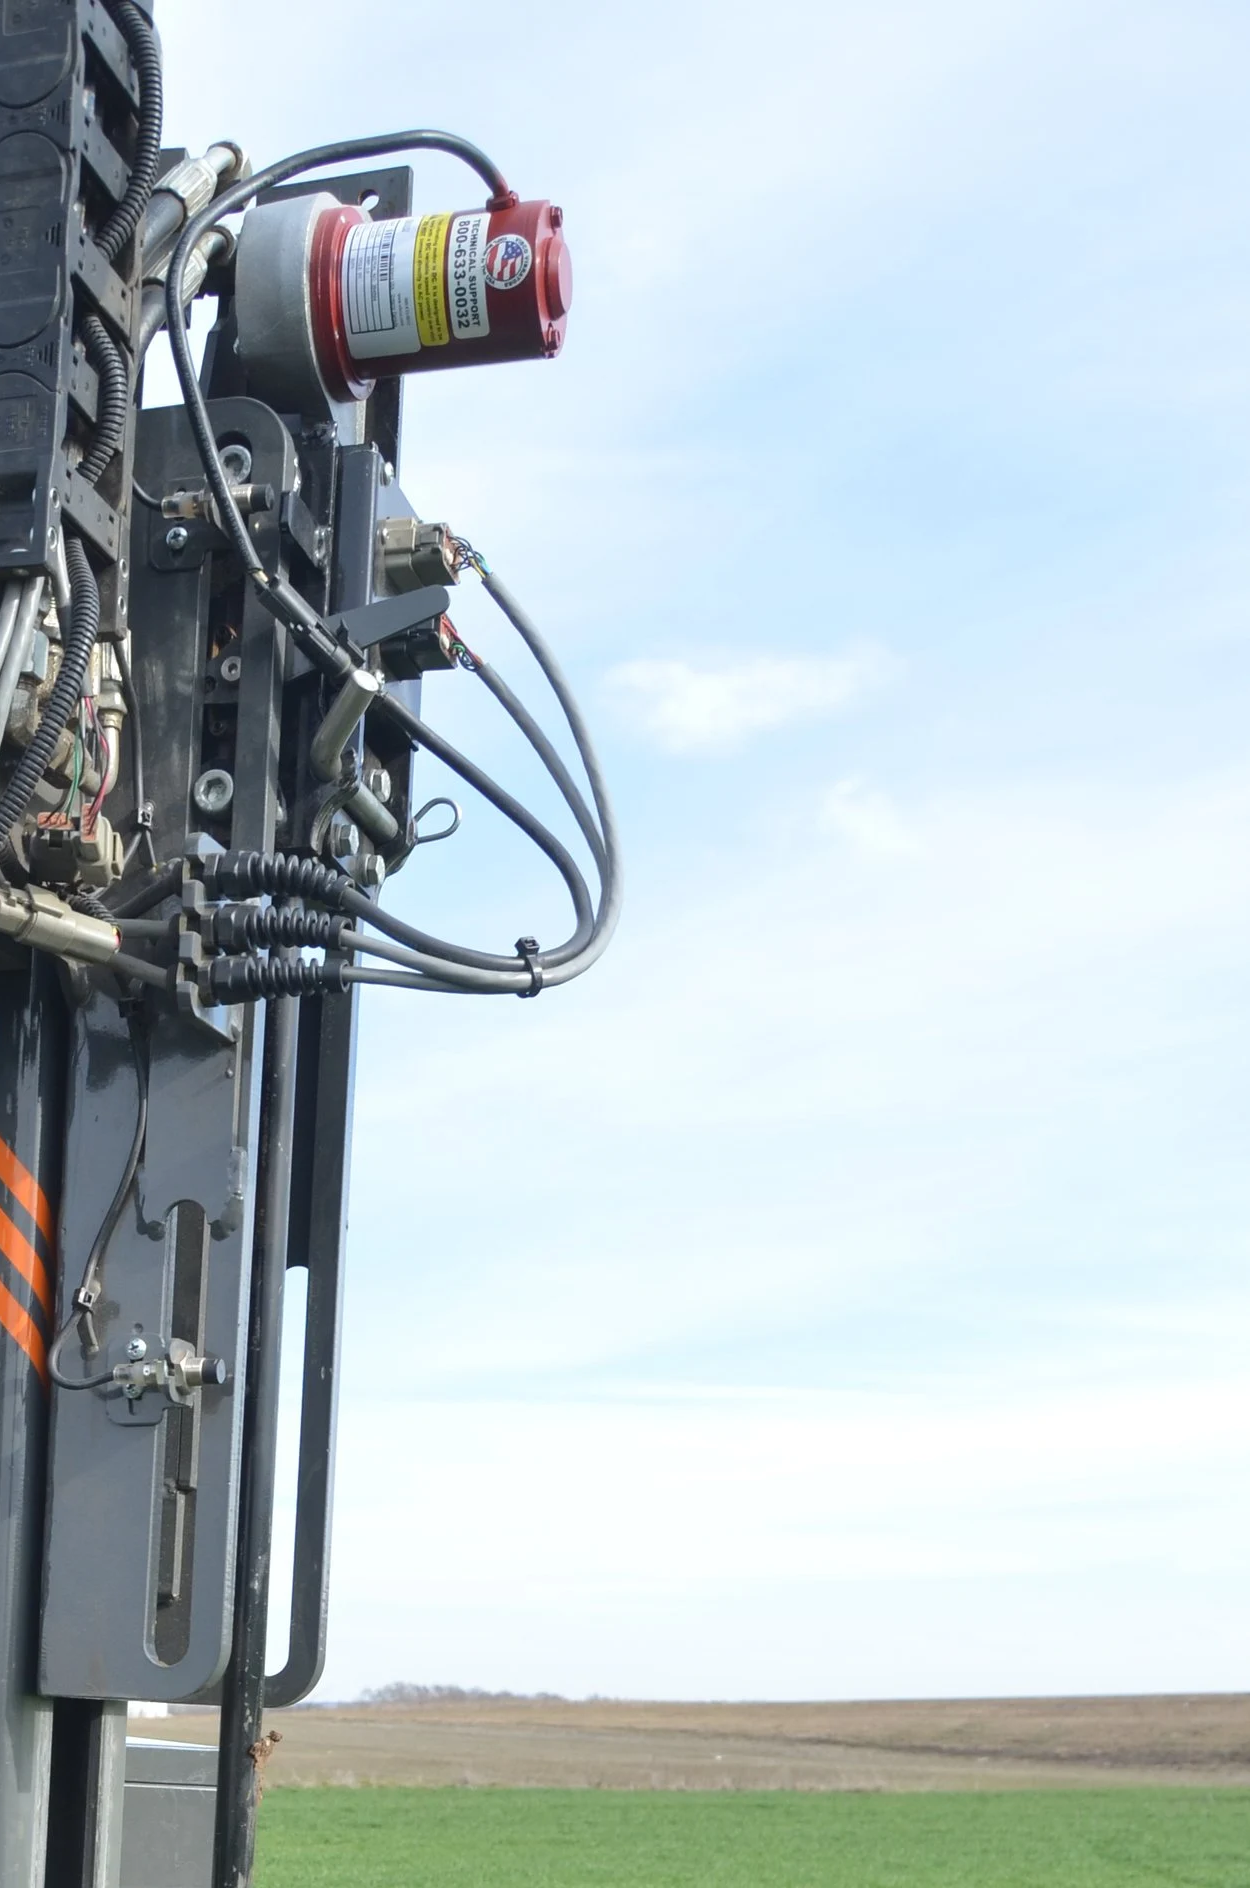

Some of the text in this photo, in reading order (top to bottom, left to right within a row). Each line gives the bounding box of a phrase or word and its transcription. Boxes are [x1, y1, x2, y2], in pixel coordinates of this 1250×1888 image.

[454, 220, 471, 329] 800-633-0032
[468, 218, 481, 327] TECHNICAL SUPPORT
